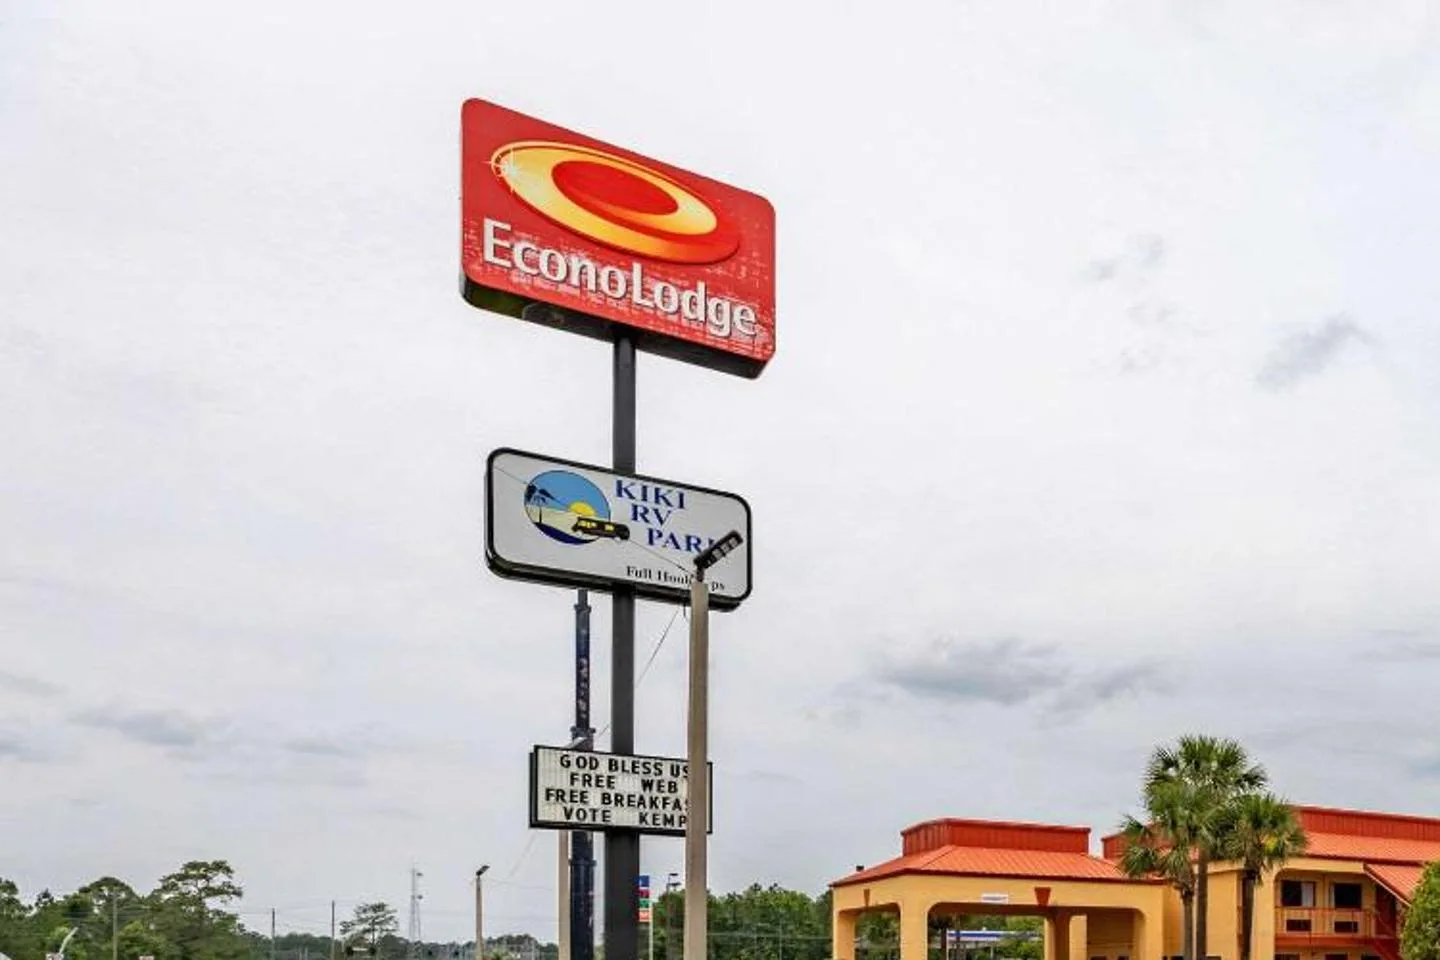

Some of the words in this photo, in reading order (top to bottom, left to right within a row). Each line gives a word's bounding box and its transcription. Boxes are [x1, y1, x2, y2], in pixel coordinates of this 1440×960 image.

[483, 218, 757, 337] EconoLodge
[616, 480, 686, 509] KIKI
[631, 504, 672, 526] RV
[626, 566, 652, 580] Full
[560, 754, 600, 771] GOD
[608, 758, 663, 776] BLESS
[569, 772, 616, 790] FREE
[641, 779, 678, 794] WEB
[545, 788, 589, 804] FREE
[563, 806, 612, 823] VOTE
[638, 812, 687, 828] KEMP
